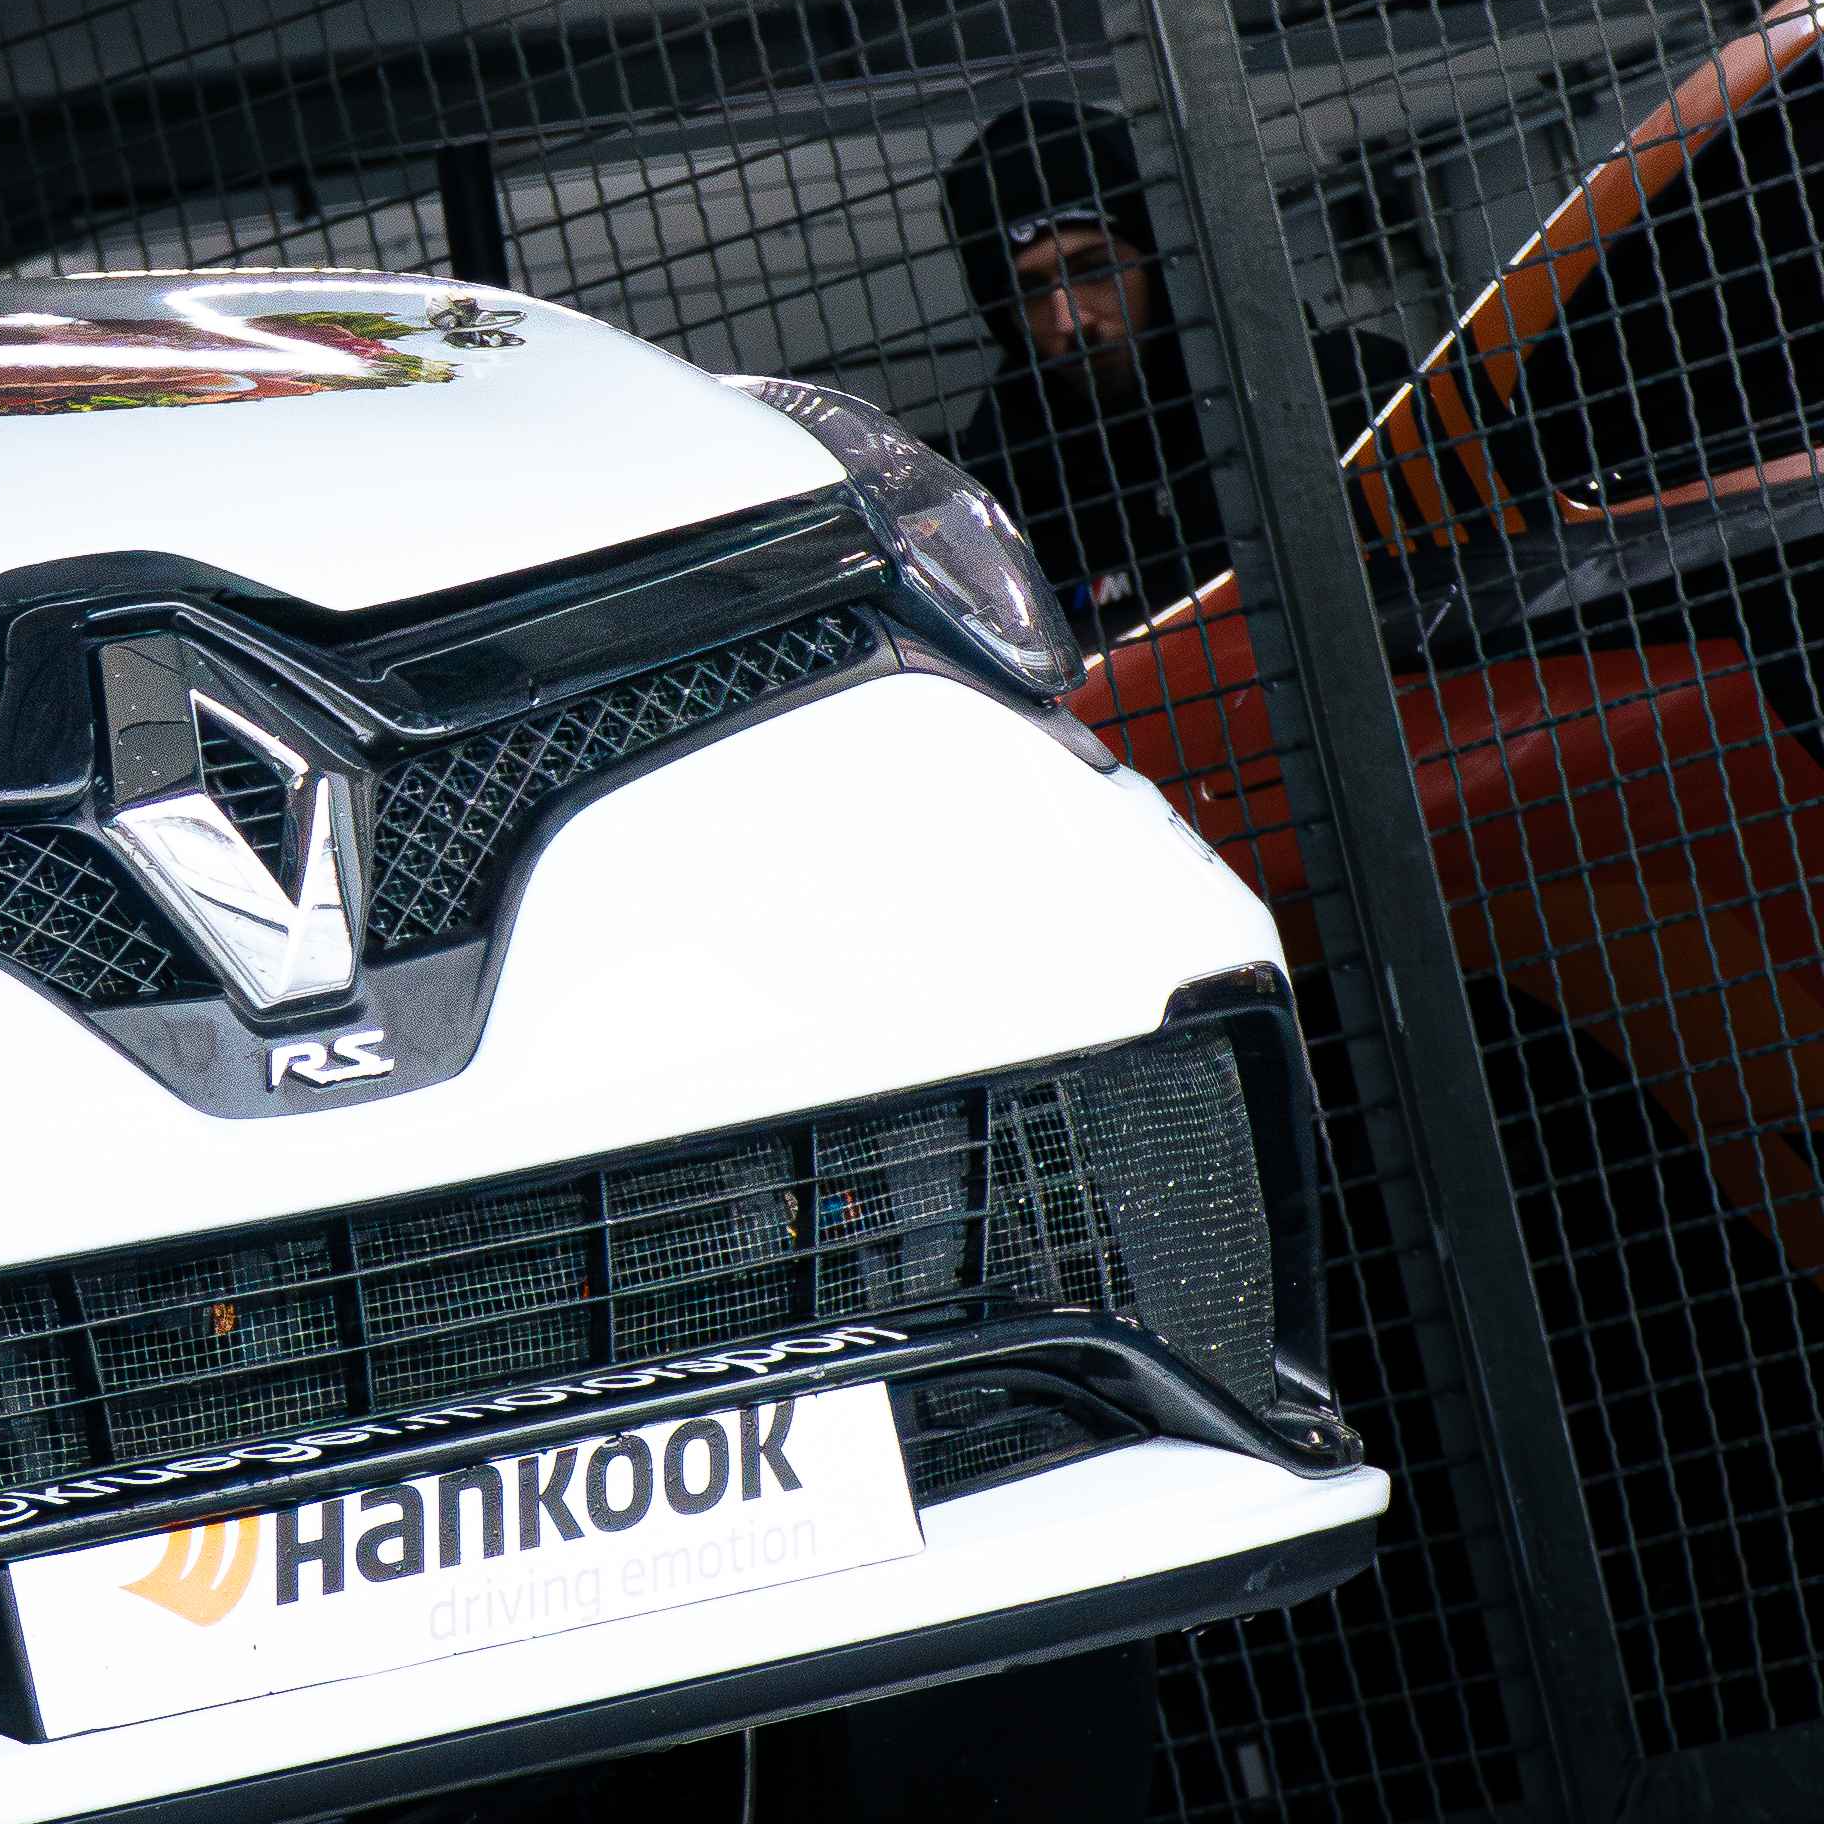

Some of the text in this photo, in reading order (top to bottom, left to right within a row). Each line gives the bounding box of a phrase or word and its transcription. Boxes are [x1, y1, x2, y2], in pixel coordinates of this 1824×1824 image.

[266, 1029, 395, 1087] RS
[428, 1519, 817, 1641] driving emotion
